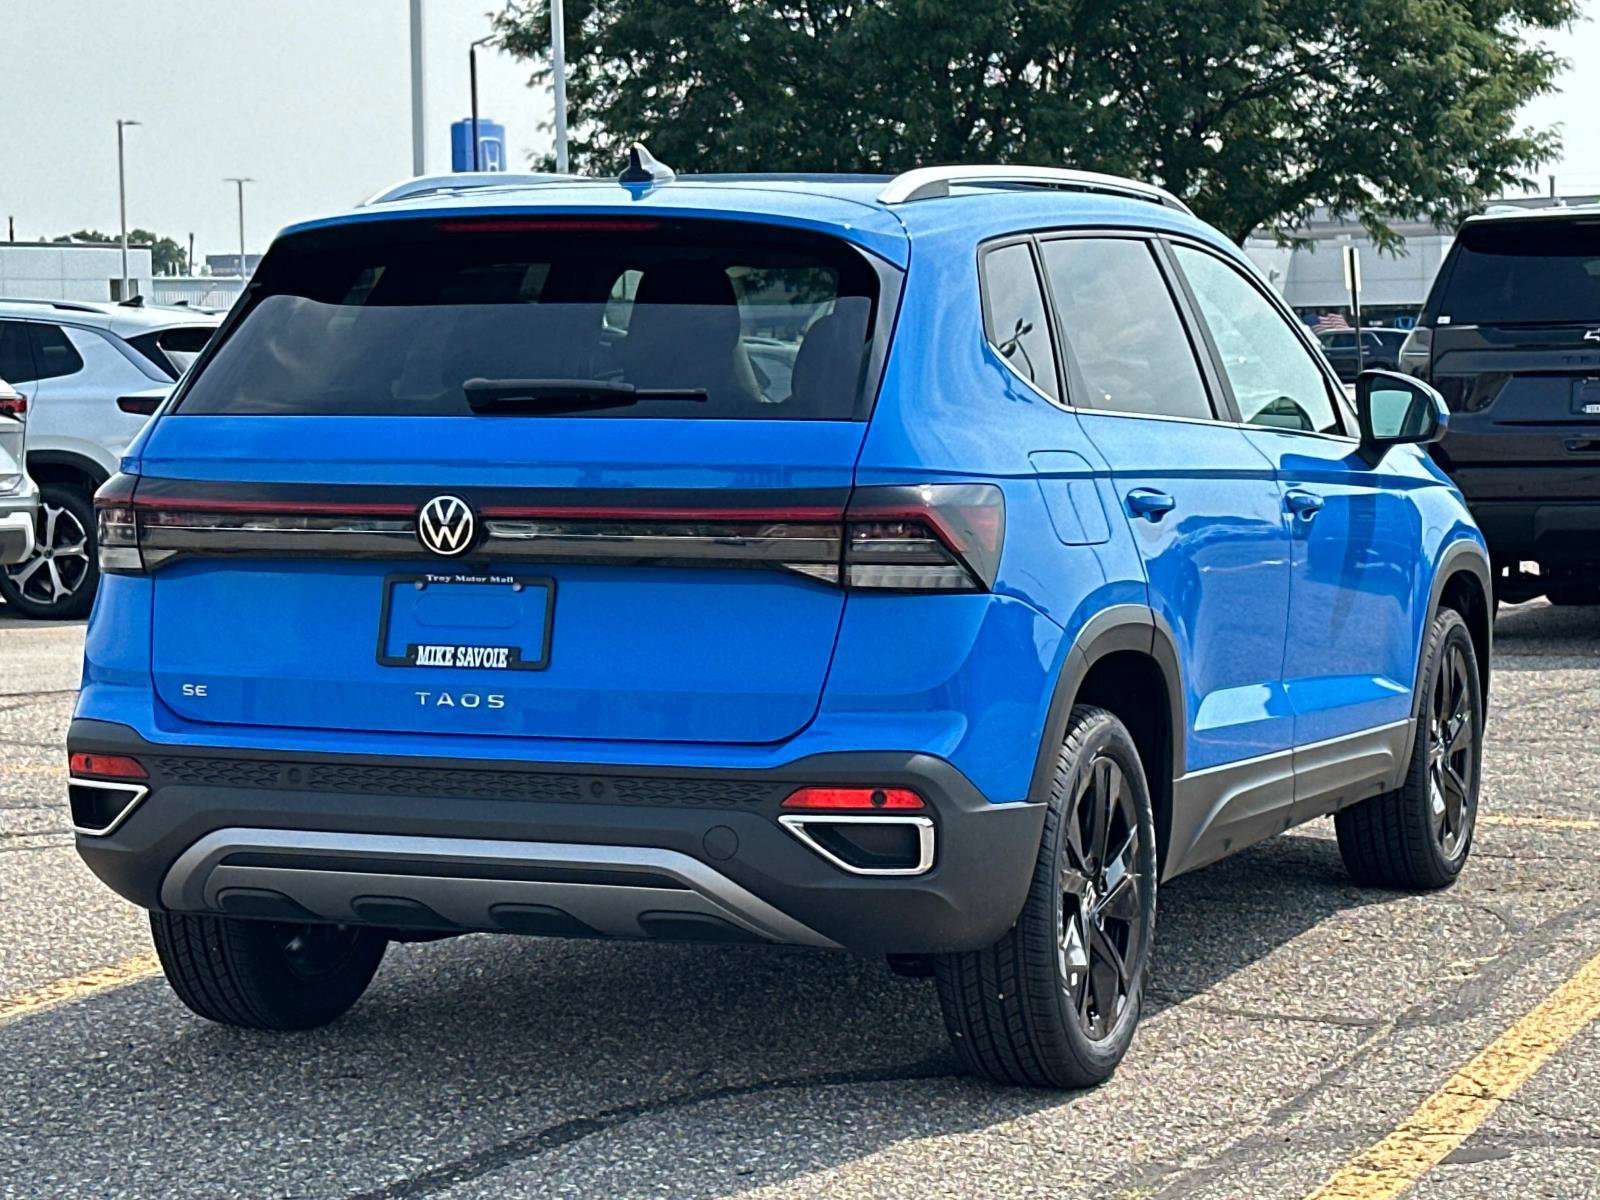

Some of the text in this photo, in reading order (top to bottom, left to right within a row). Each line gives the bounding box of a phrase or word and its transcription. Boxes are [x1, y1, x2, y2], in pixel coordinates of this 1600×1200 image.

[425, 574, 514, 584] Troy Motor Mall
[416, 645, 509, 668] MIKE SAVOIE
[182, 683, 208, 697] SE
[415, 691, 505, 709] TAOS
